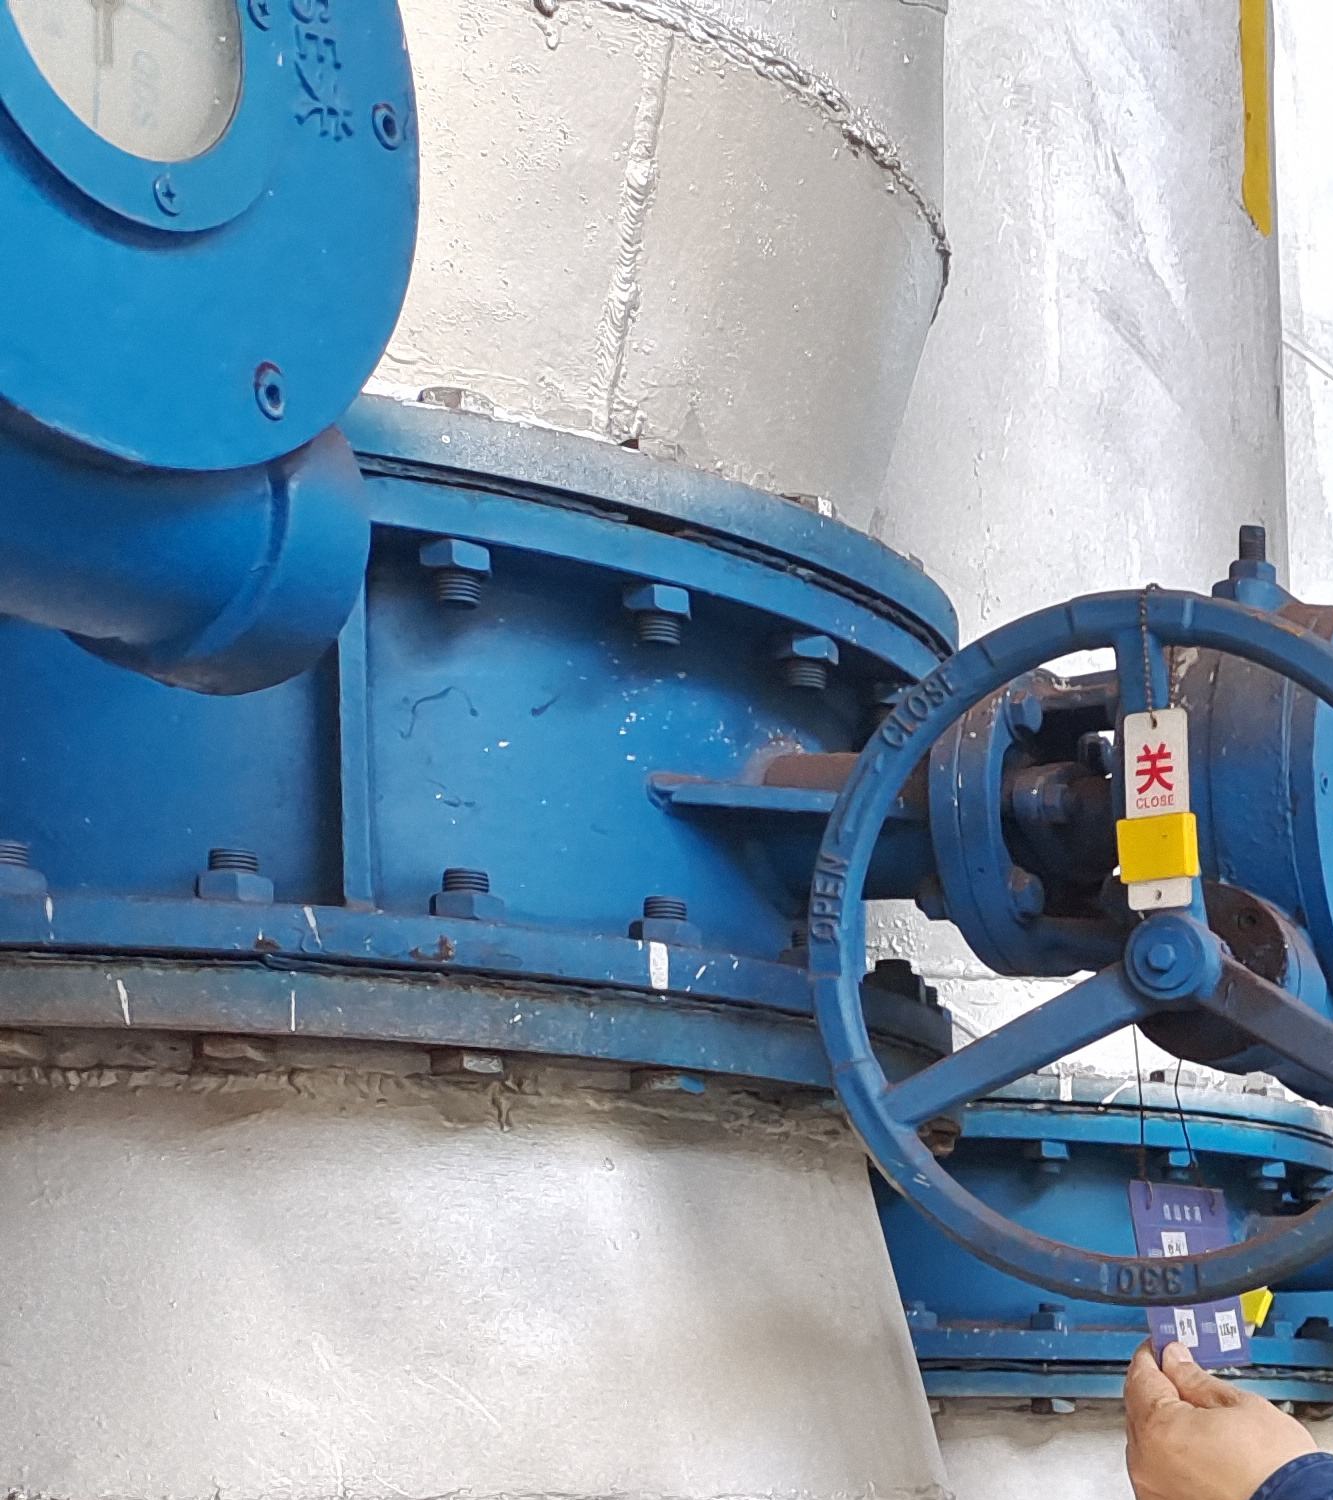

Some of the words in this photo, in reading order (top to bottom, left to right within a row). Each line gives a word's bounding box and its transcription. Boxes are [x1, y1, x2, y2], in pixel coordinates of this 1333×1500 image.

[880, 667, 957, 749] CLOSE
[1135, 742, 1175, 795] 关
[1135, 794, 1175, 810] CLOSE
[810, 851, 850, 945] OPEN
